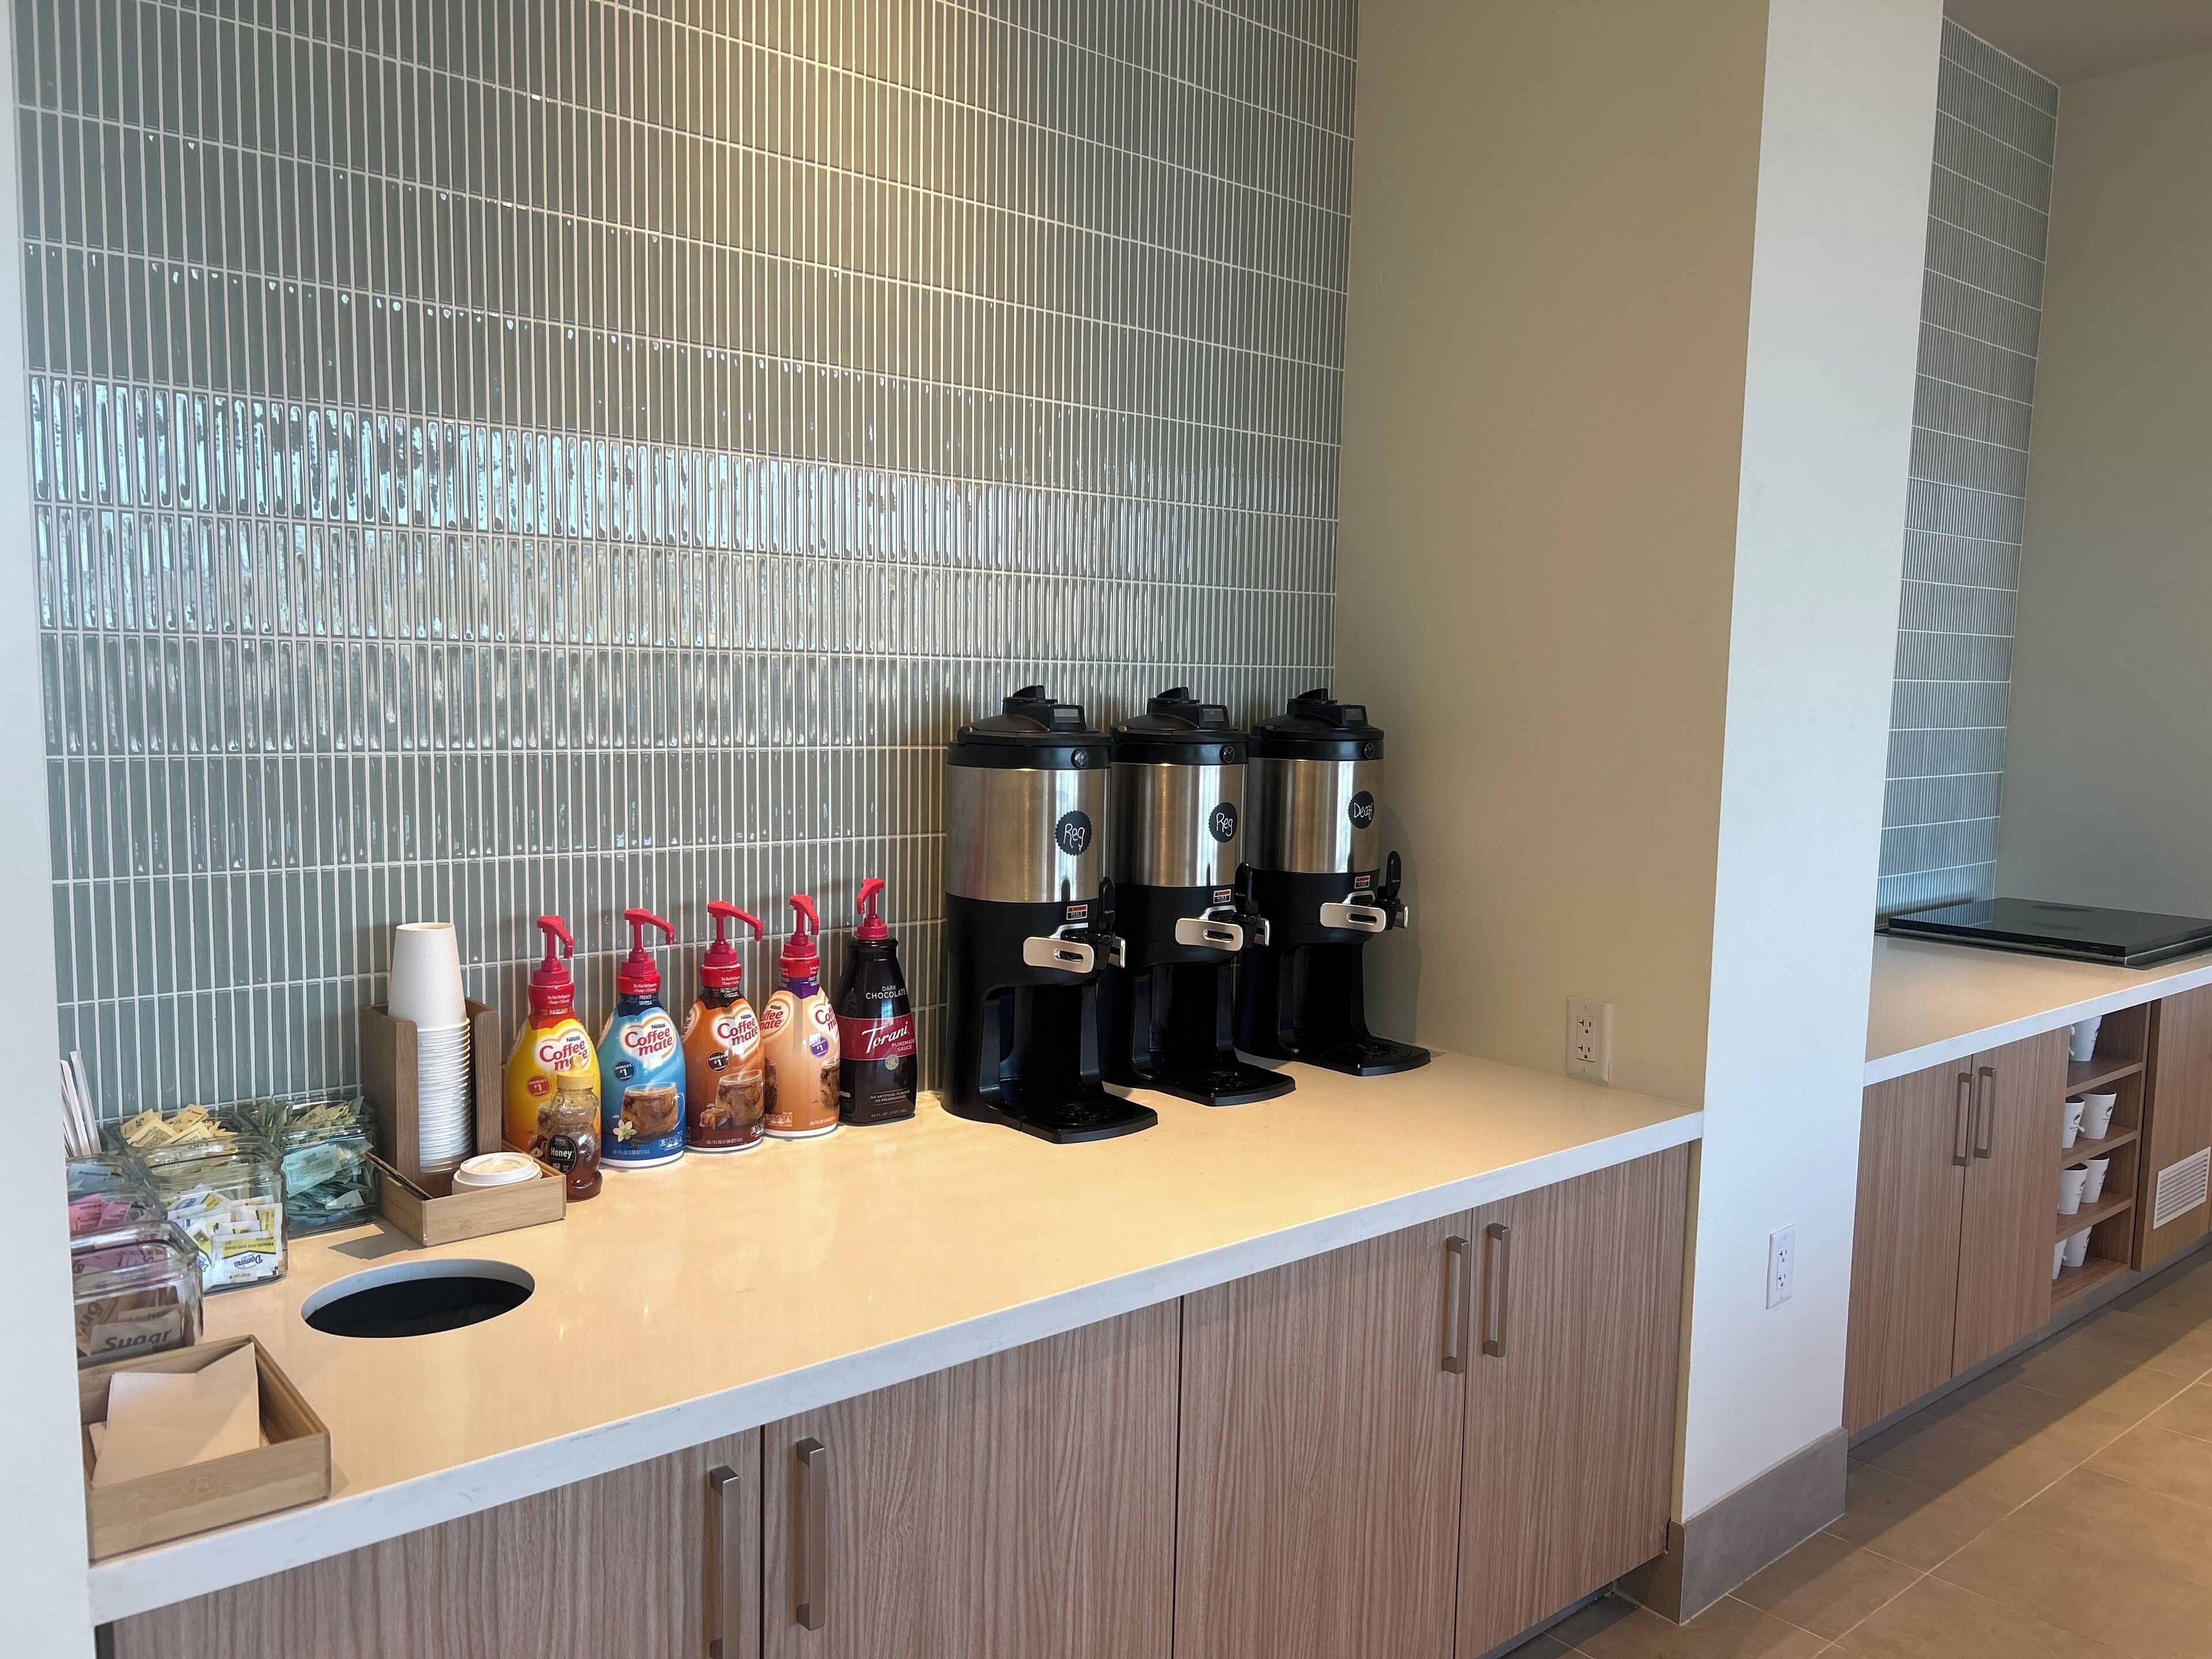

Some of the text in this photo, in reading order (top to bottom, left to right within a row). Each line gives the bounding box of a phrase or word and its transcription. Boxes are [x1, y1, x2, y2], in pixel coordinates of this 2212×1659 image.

[1354, 802, 1374, 820] Decaf
[1216, 813, 1233, 837] Reg
[1063, 823, 1085, 853] Reg
[865, 988, 907, 999] CHOCOLATE
[815, 1007, 836, 1025] Coff
[624, 1028, 670, 1048] Coffee
[717, 1018, 756, 1039] Coffee
[732, 1026, 758, 1046] mate
[862, 1021, 908, 1054] Torani
[539, 1040, 585, 1062] Coffee
[639, 1036, 673, 1056] mate
[892, 1038, 915, 1047] PUREMADE
[554, 1049, 588, 1071] me
[714, 1059, 722, 1067] #1
[620, 1068, 627, 1076] #1
[534, 1084, 543, 1092] #1
[551, 1147, 573, 1160] Honey
[234, 1255, 263, 1267] Domino
